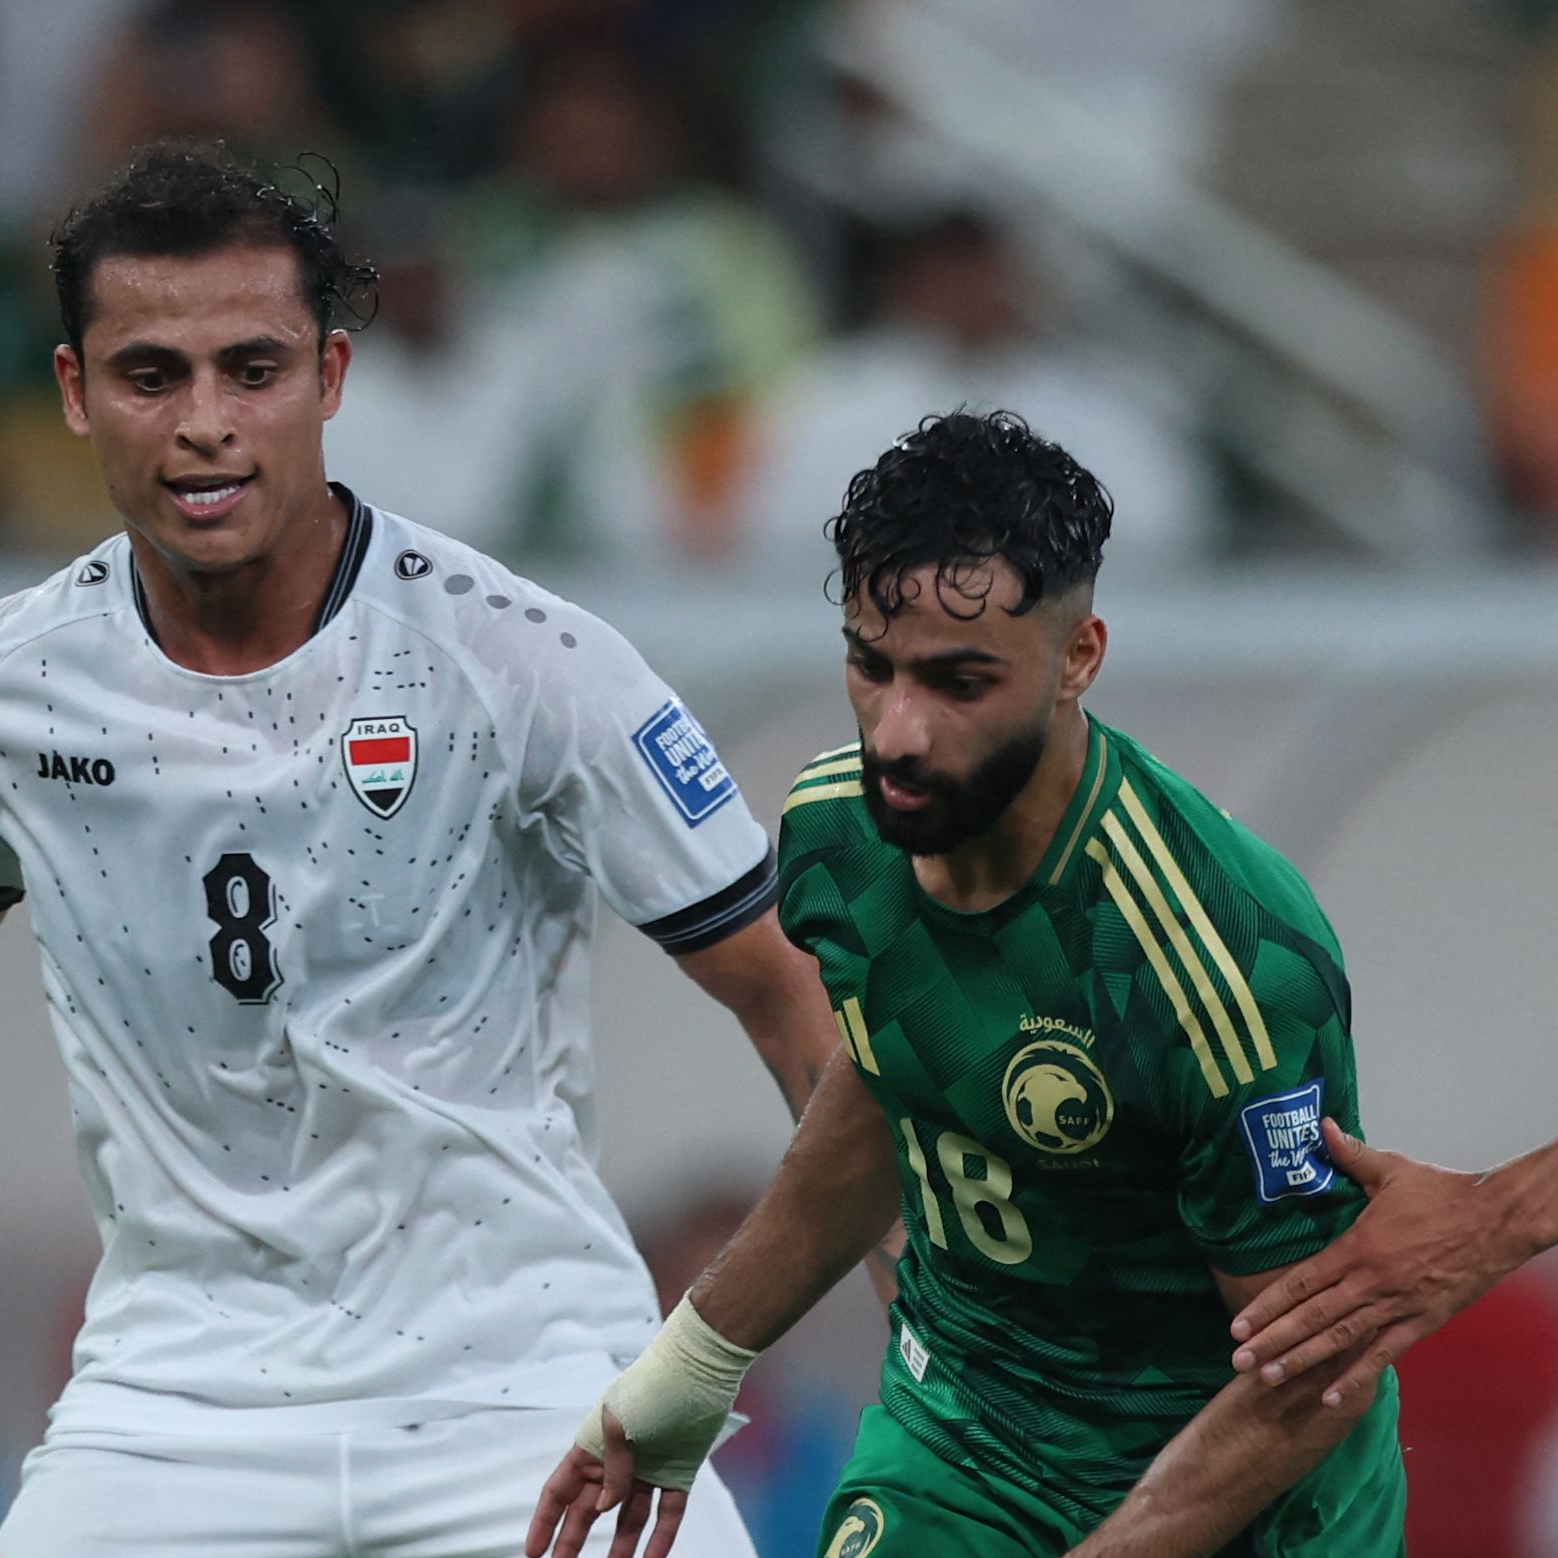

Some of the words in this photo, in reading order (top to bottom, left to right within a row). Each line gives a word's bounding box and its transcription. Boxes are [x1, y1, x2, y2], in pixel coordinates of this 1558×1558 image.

[357, 723, 401, 735] IRAQ
[664, 731, 704, 767] UNIT
[37, 753, 116, 786] JAKO
[202, 853, 285, 1005] 8
[1019, 1013, 1096, 1049] السعودية
[1059, 1115, 1090, 1125] SAFF
[1262, 1104, 1317, 1128] FOOTBALL
[1267, 1121, 1320, 1149] UNITES
[1268, 1150, 1291, 1167] the
[900, 1117, 1033, 1265] 18
